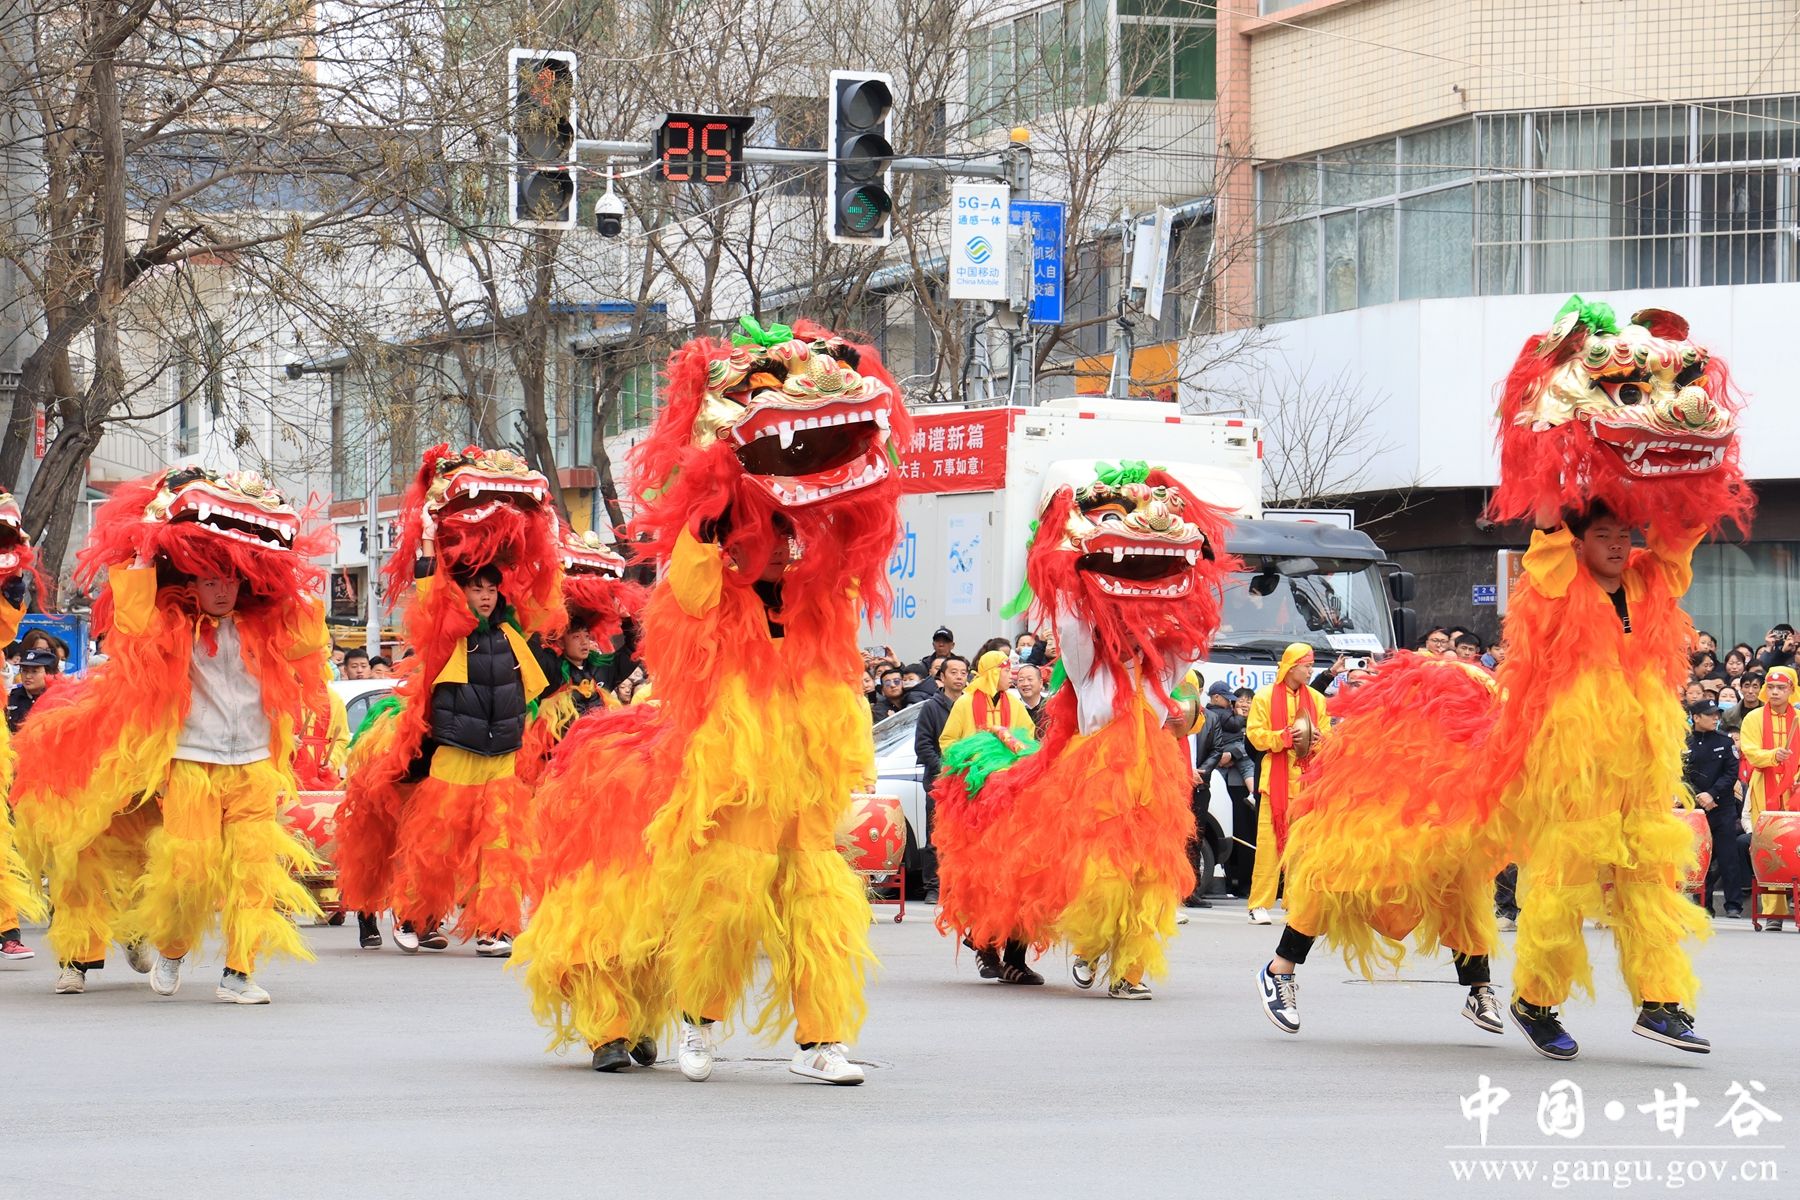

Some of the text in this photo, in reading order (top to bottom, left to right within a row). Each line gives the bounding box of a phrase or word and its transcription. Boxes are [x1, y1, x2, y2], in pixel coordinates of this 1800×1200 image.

[663, 122, 731, 182] 25
[959, 197, 1000, 209] 5G-A
[958, 215, 1000, 226] 通感一体
[957, 266, 999, 278] 中国移动
[1034, 265, 1056, 278] 人自
[1034, 284, 1055, 297] 交通
